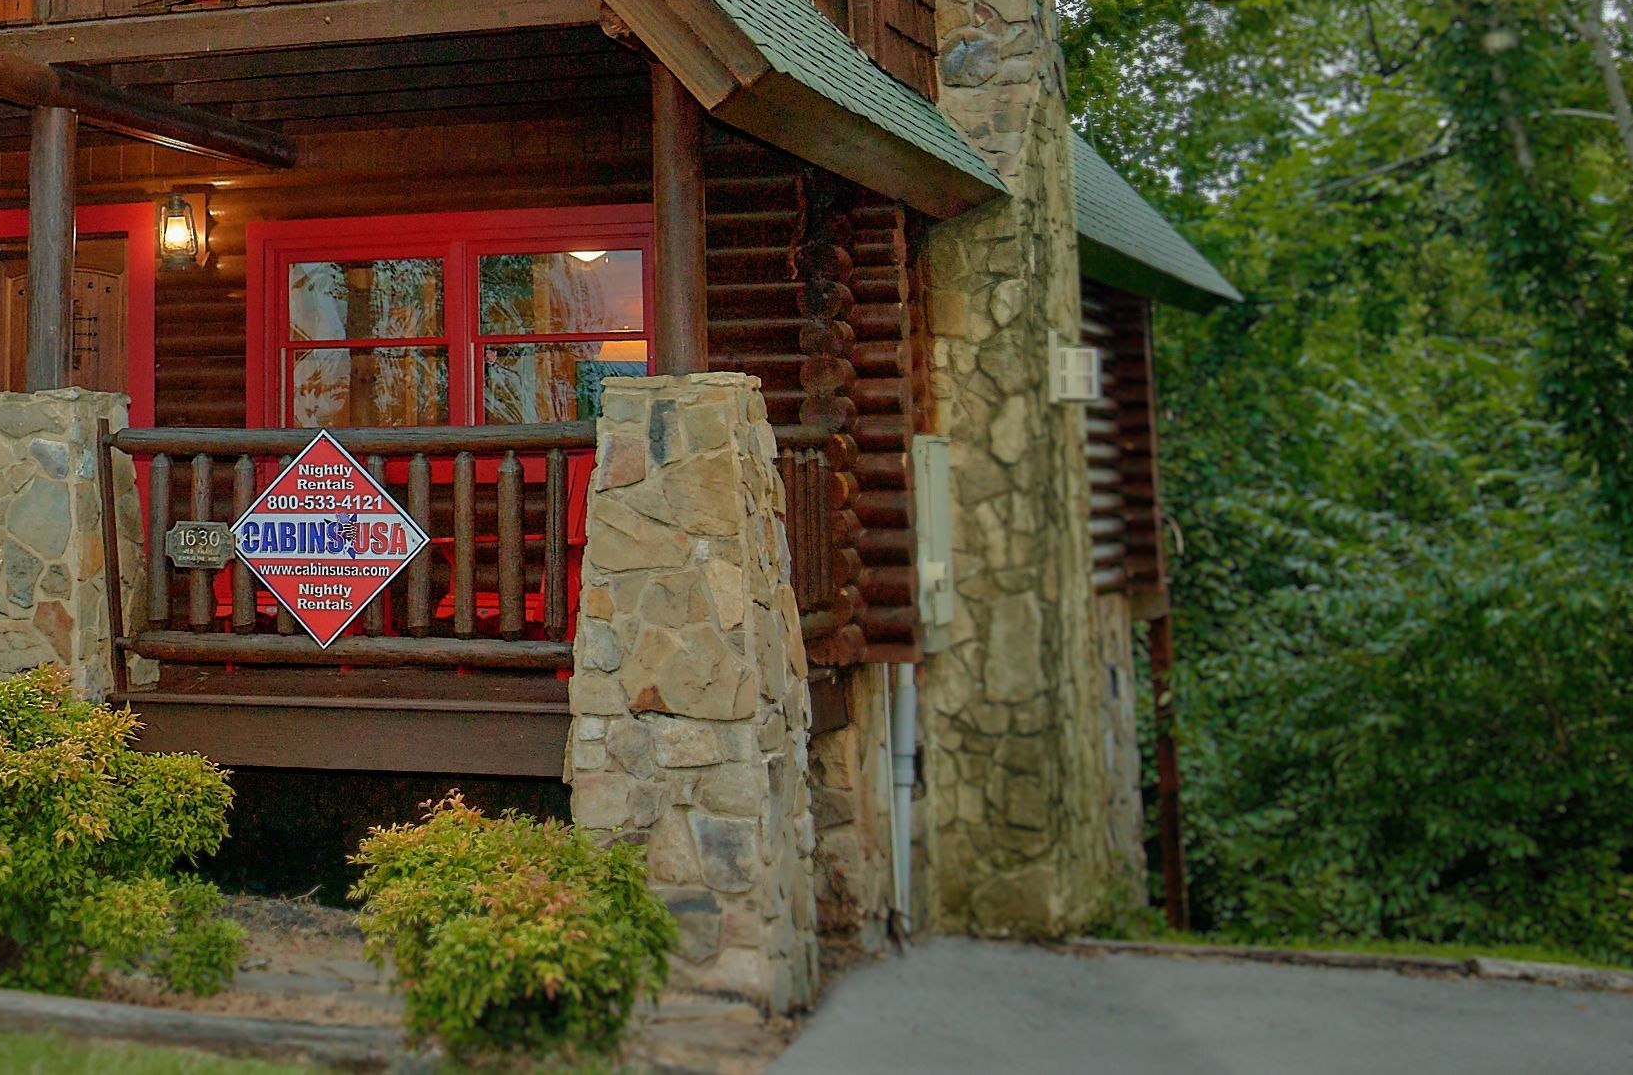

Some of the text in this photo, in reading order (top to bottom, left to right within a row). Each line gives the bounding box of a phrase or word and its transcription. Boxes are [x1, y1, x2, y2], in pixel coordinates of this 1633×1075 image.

[298, 464, 353, 477] Nightly
[297, 479, 355, 491] Rentals
[267, 495, 383, 510] 800-533-4121
[177, 529, 220, 546] 1630
[241, 521, 408, 555] CABINS USA
[259, 563, 390, 577] www.cabinsusa.com
[298, 583, 352, 597] Nightly
[297, 598, 353, 610] Rentals
